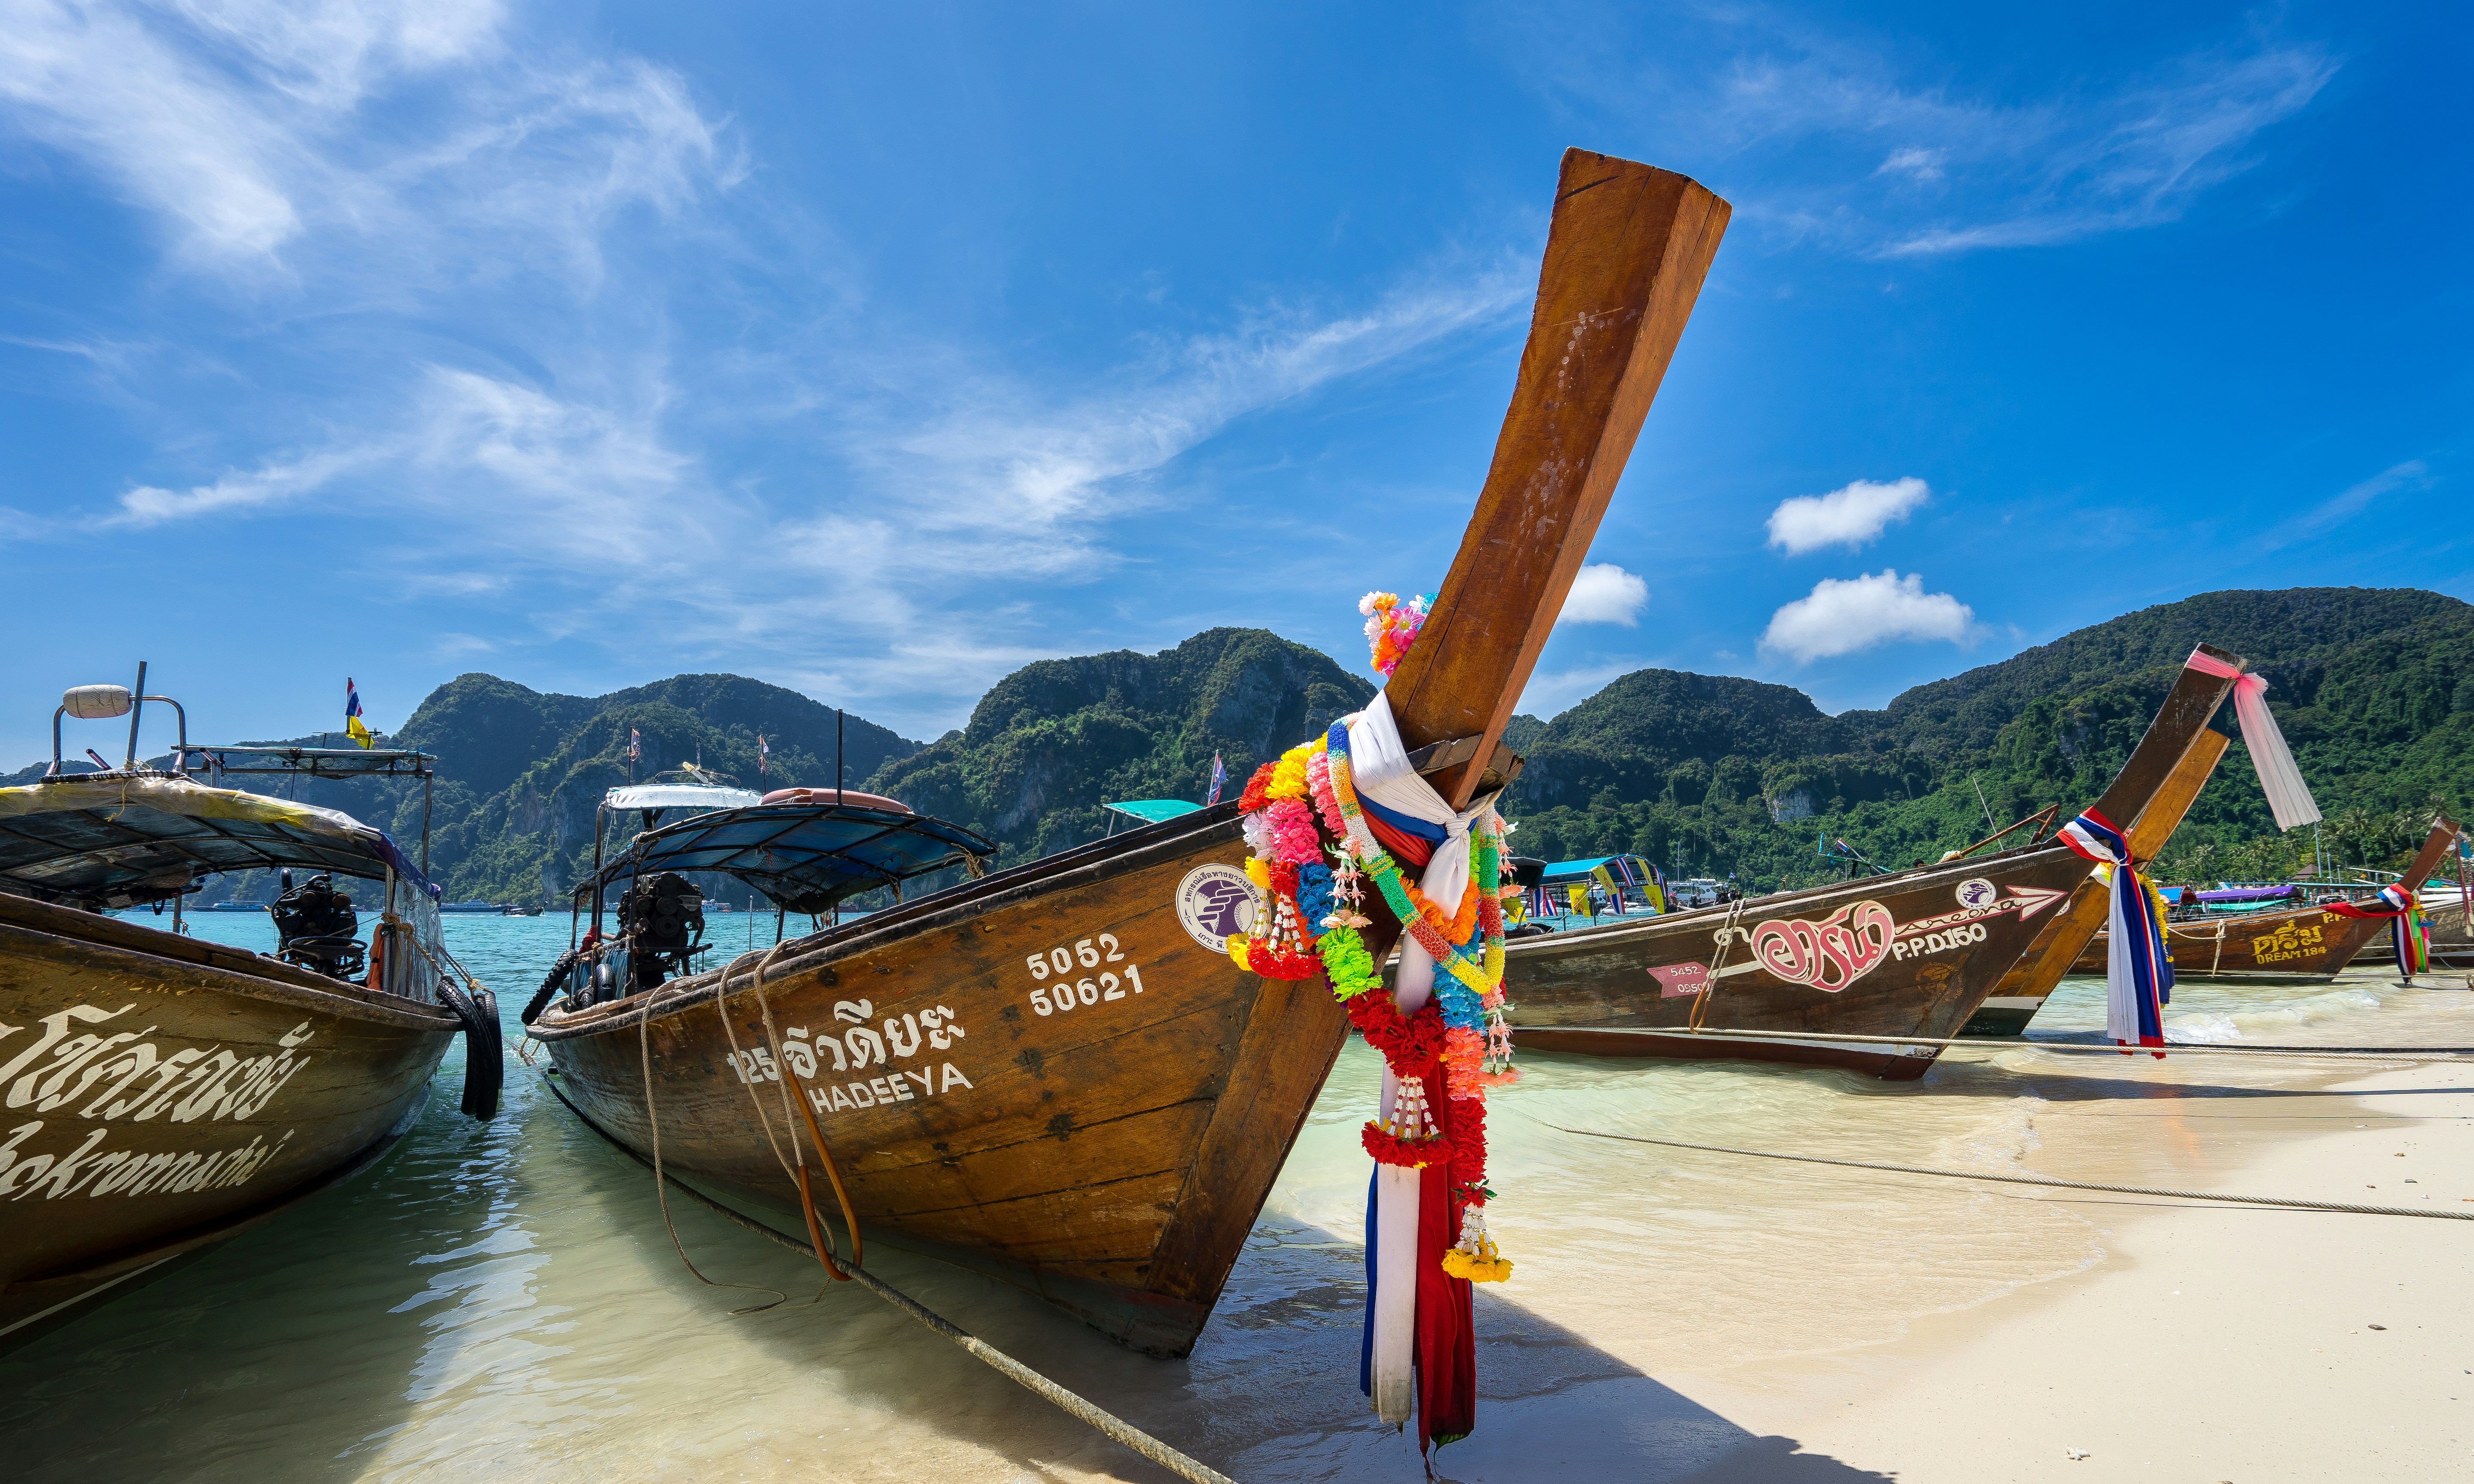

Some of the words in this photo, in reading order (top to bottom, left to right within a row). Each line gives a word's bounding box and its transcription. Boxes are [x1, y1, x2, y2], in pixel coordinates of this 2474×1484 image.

[1027, 933, 1124, 980] 5052
[1670, 966, 1702, 977] 5452
[2256, 951, 2301, 964] DREAM
[1029, 964, 1144, 1016] 50621
[726, 1047, 780, 1084] 125
[809, 1062, 974, 1113] HADEEYA
